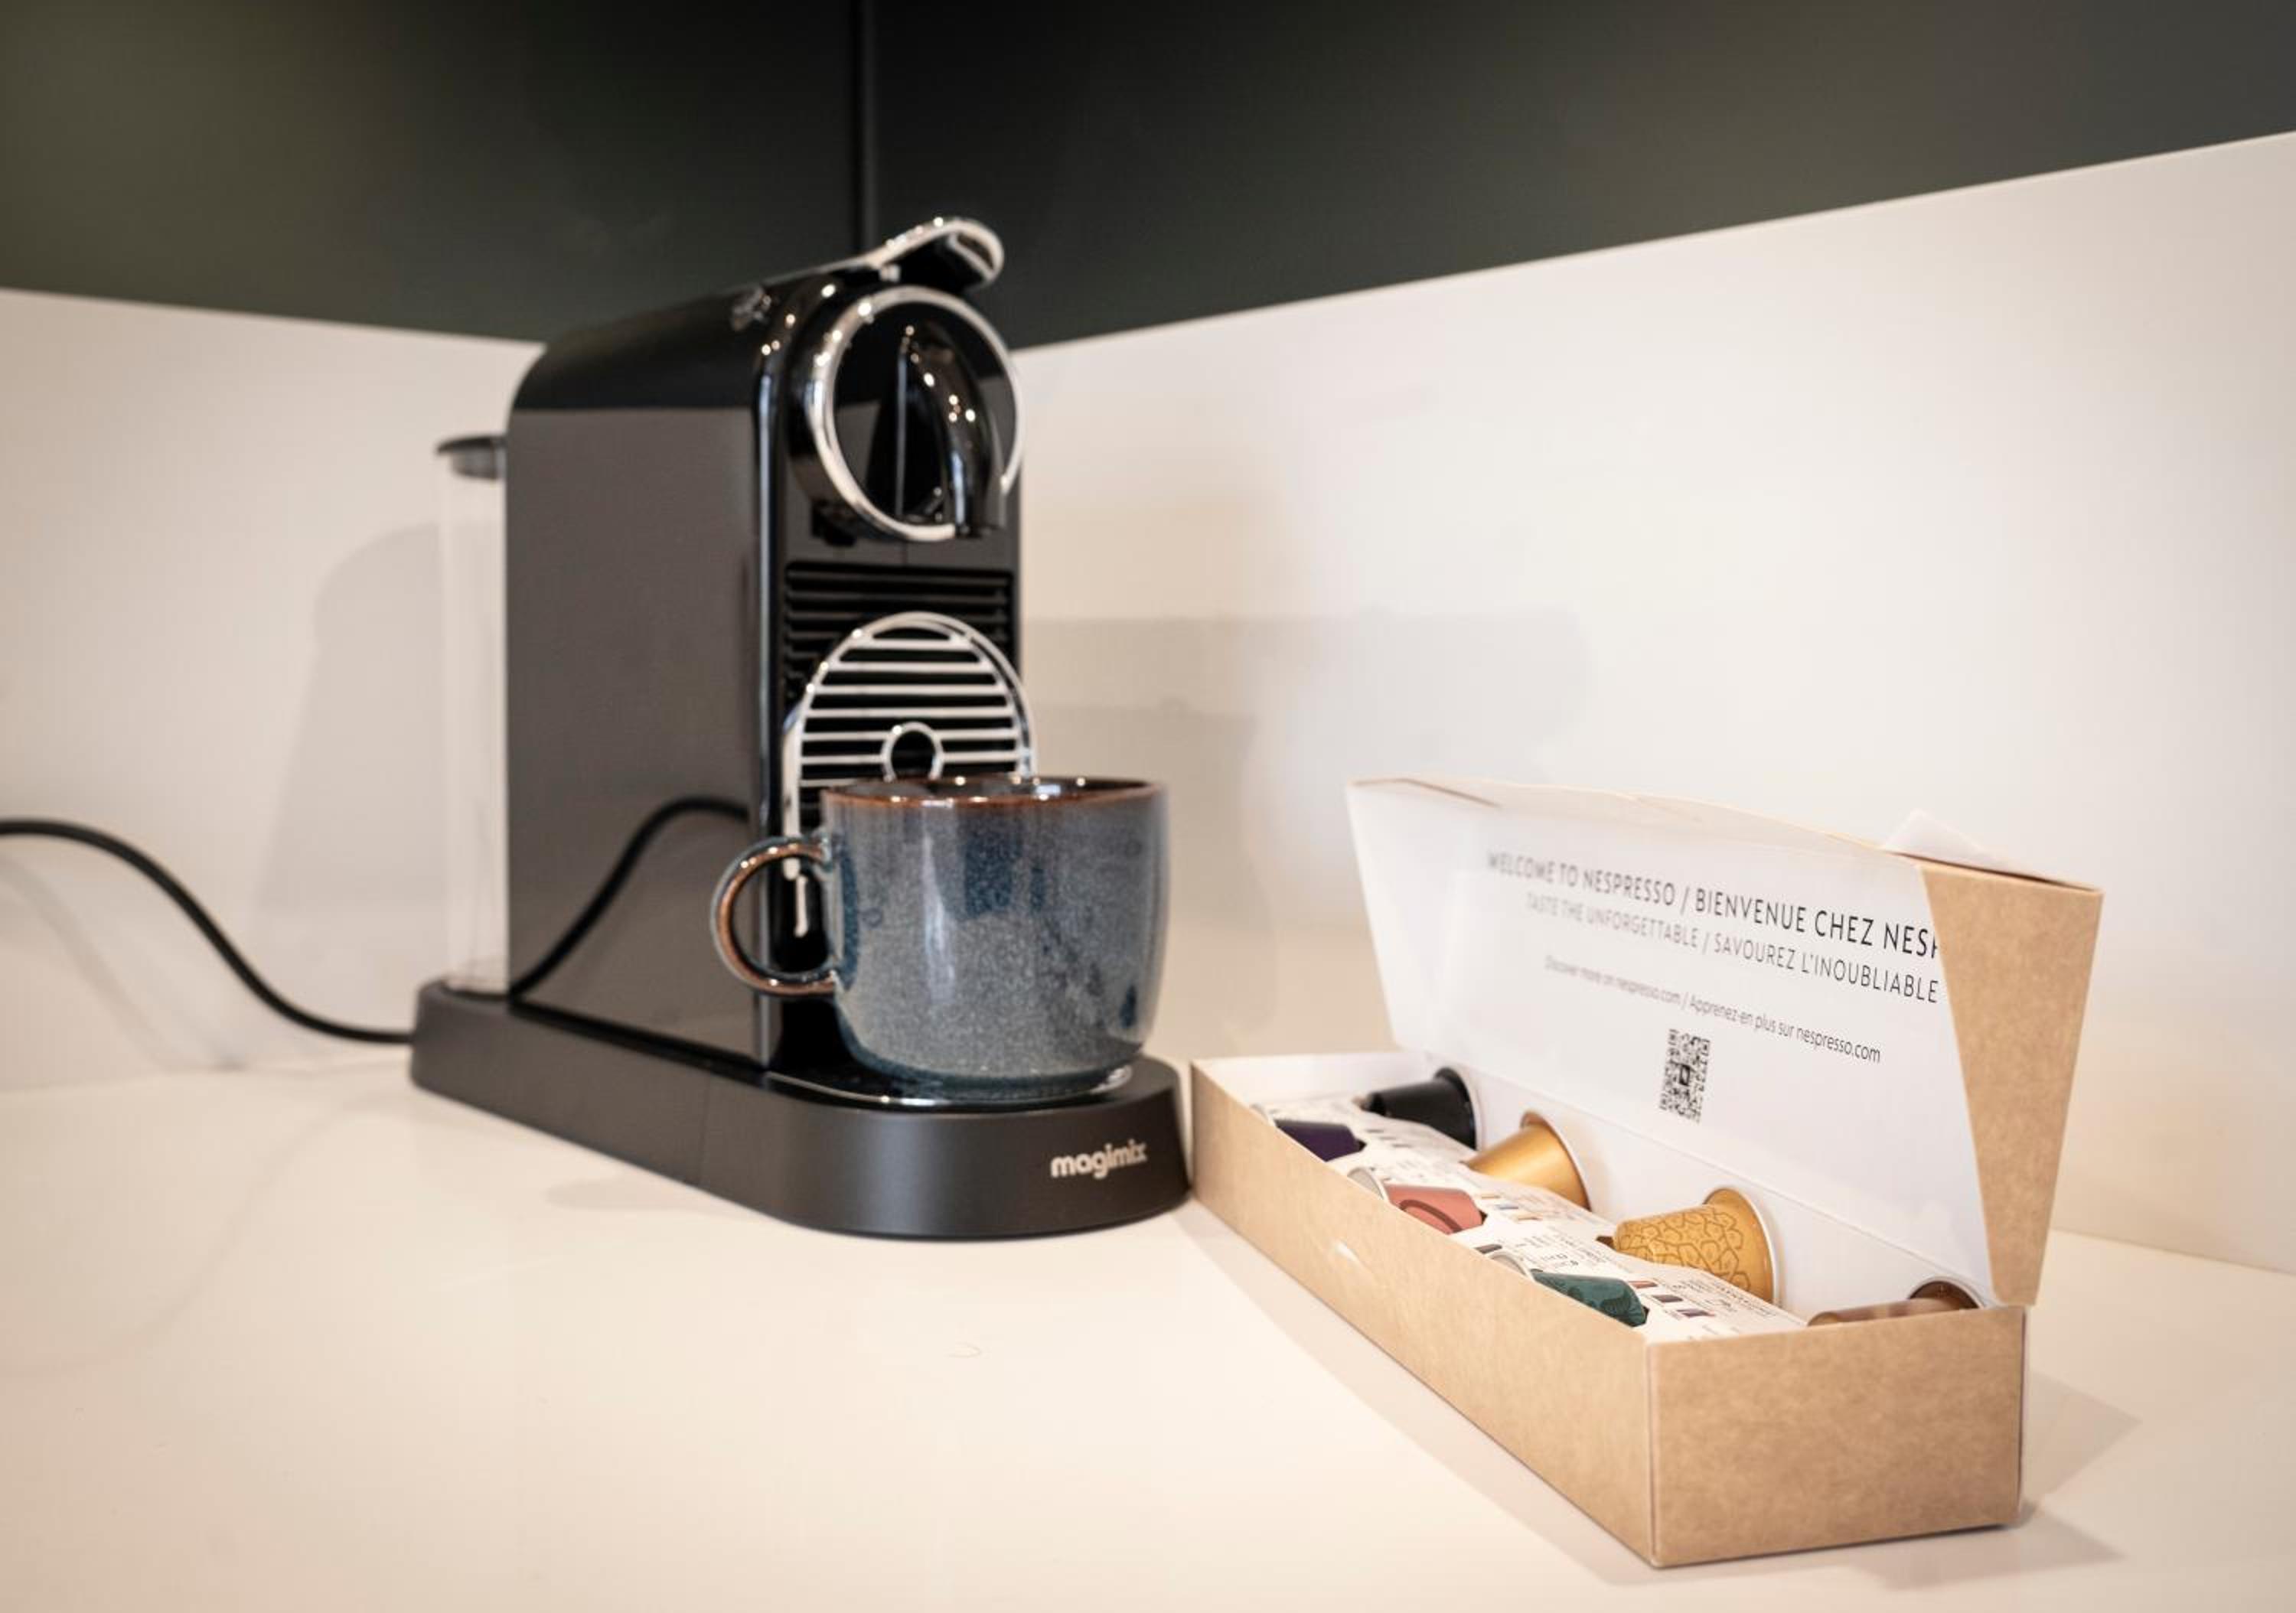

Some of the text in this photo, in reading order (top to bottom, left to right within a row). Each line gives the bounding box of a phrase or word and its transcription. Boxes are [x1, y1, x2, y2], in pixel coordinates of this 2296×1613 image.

[1487, 852, 1555, 884] WELCOME
[1559, 862, 1579, 888] TO
[1583, 869, 1675, 906] NESPRESSO
[1679, 885, 1690, 916] /
[1695, 888, 1806, 933] BIENVENUE
[1815, 910, 1874, 947] CHEZ
[1528, 892, 1559, 917] TASTE
[1561, 898, 1584, 921] THE
[1587, 906, 1698, 948] UNFORGETTABLE
[1714, 932, 1795, 971] SAVOUREZ
[1802, 952, 1939, 1003] L'INOUBLIABLE
[1690, 995, 1753, 1025] Apprenez-en
[1755, 1012, 1776, 1035] plus
[1778, 1022, 1795, 1039] sur
[1796, 1026, 1881, 1064] nespresso.com
[1051, 1139, 1148, 1179] magimix
